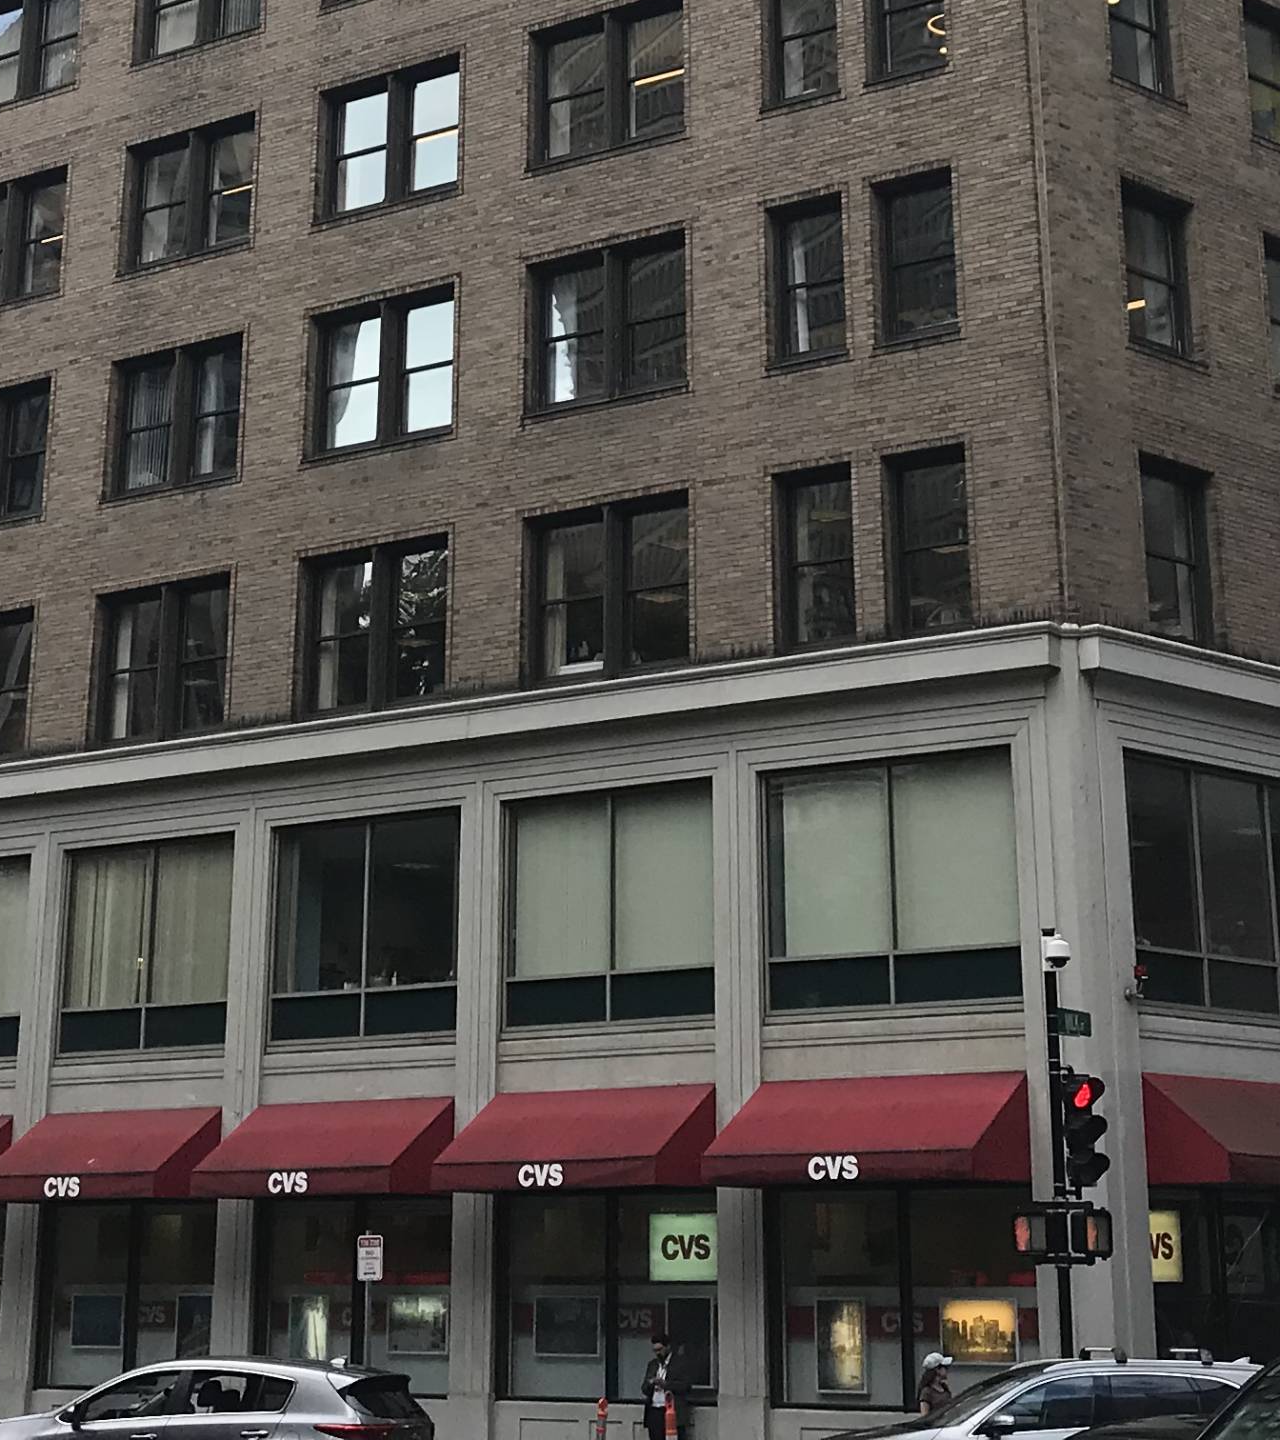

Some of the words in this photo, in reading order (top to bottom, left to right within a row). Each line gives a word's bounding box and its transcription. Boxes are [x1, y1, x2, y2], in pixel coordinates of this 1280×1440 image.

[518, 1163, 564, 1188] CVS
[808, 1155, 859, 1181] CVS
[43, 1176, 81, 1198] CVS
[267, 1171, 308, 1194] CVS
[660, 1234, 711, 1261] CVS
[1149, 1232, 1174, 1260] VS
